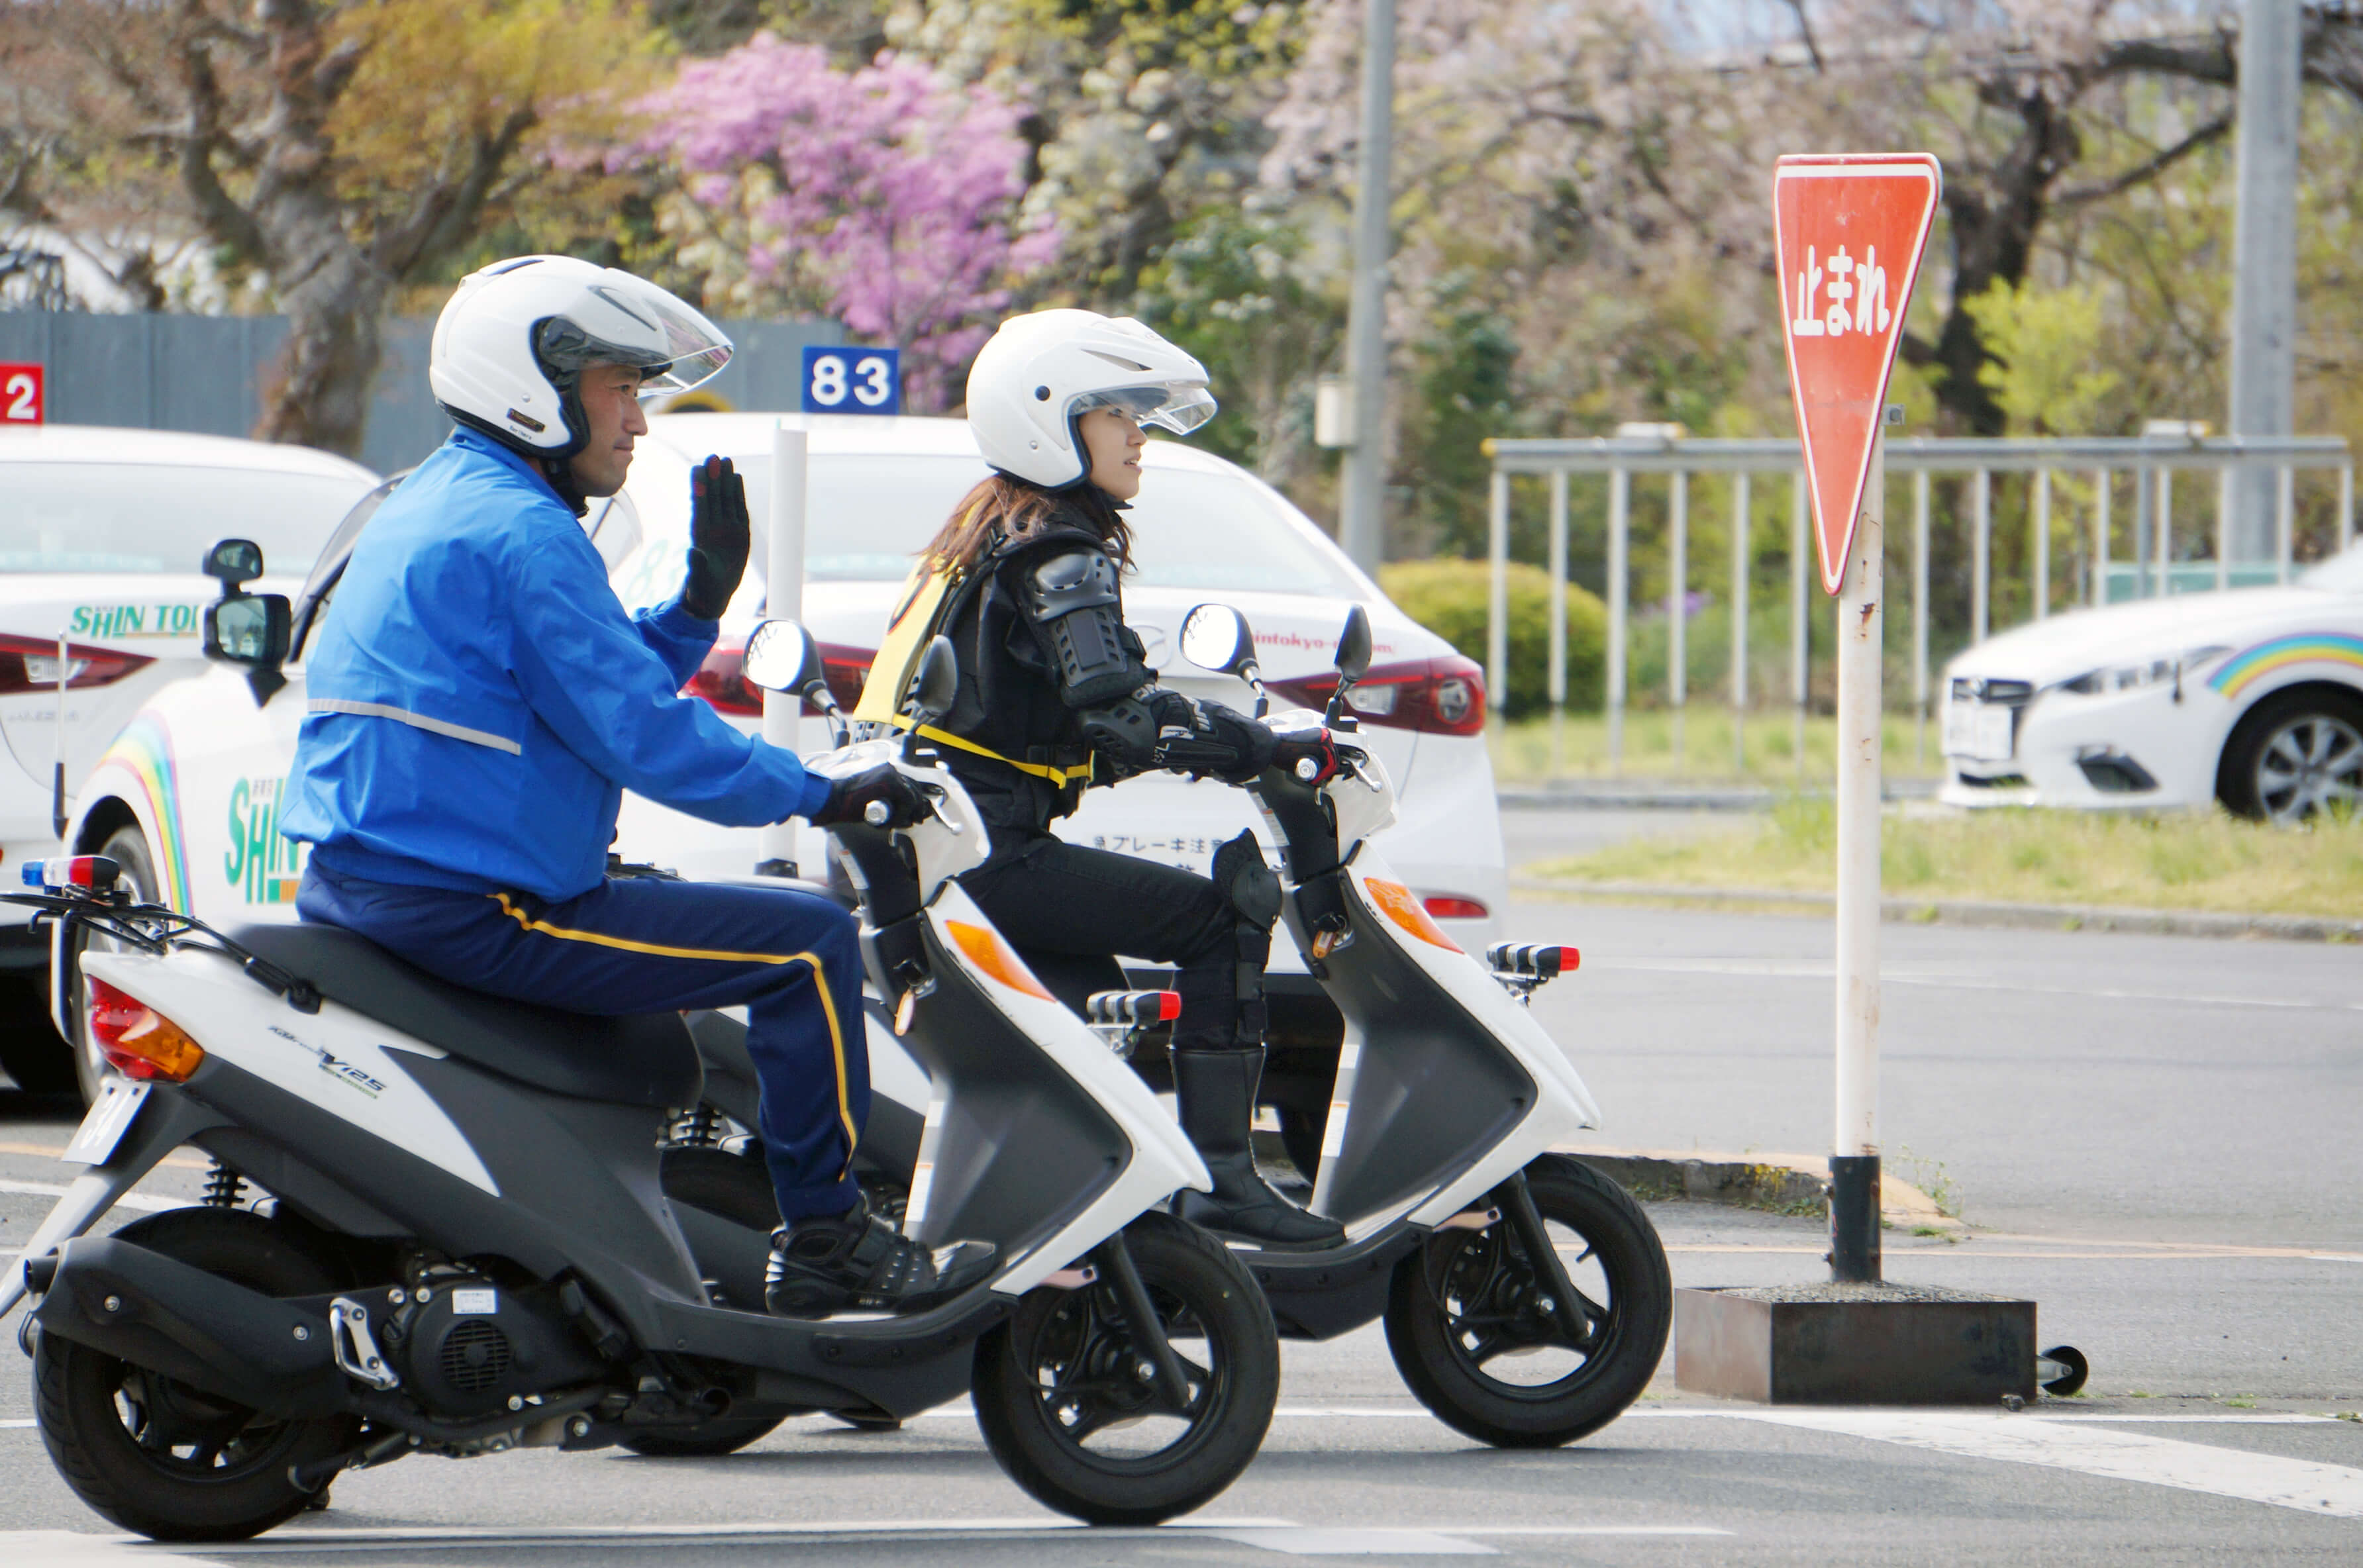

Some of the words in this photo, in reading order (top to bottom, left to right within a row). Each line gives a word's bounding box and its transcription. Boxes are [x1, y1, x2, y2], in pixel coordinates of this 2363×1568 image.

[1793, 244, 1890, 336] 止まれ
[6, 373, 36, 419] 2
[811, 355, 891, 406] 83
[70, 605, 145, 640] SHIN
